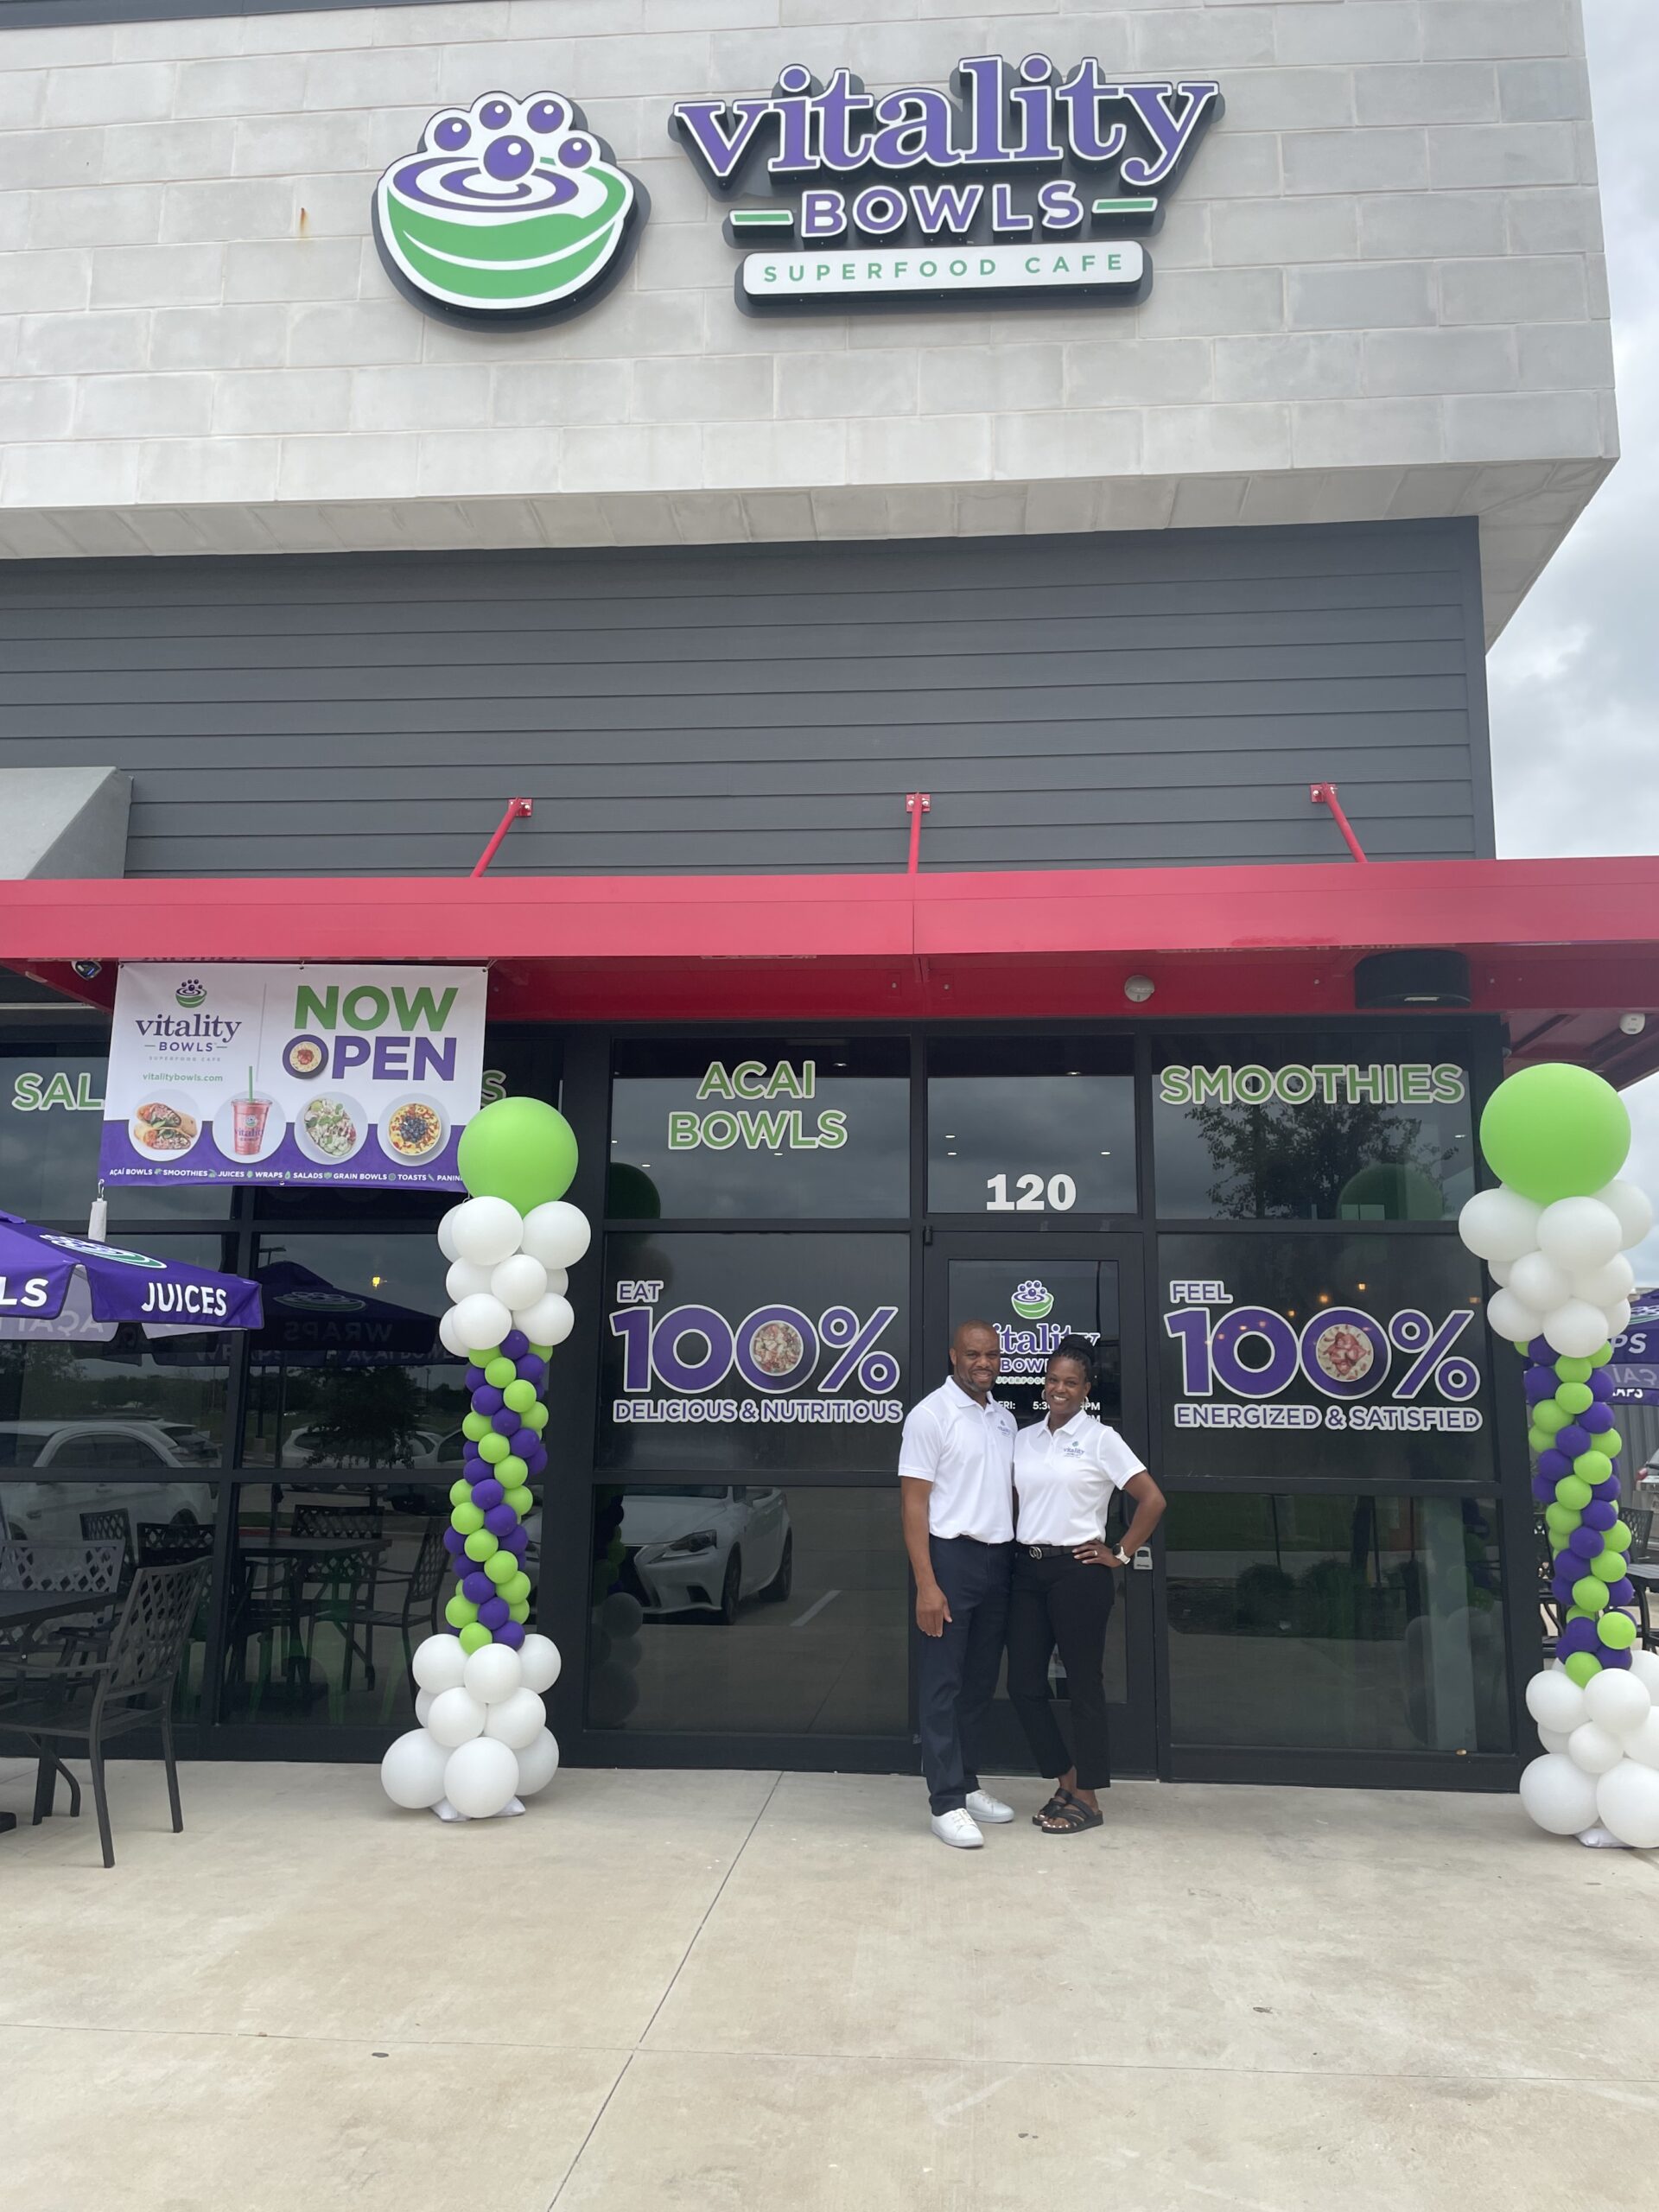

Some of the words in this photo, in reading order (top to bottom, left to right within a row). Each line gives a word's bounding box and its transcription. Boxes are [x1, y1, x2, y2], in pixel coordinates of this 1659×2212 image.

[674, 52, 1220, 188] vitality
[800, 181, 1084, 239] BOWLS
[763, 257, 996, 283] SUPERFOOD
[1025, 253, 1127, 275] CAFE
[295, 985, 459, 1032] NOW
[135, 1014, 242, 1043] vitality
[159, 1041, 213, 1052] BOWLS
[283, 1034, 457, 1081] OPEN
[12, 1072, 105, 1111] SAL
[143, 1072, 223, 1082] vitalitybowls.com
[696, 1060, 816, 1100] ACAI
[1160, 1064, 1465, 1104] SMOOTHIES
[668, 1109, 848, 1150] BOWLS
[986, 1173, 1077, 1211] 120
[141, 1282, 227, 1316] JUICES
[616, 1280, 664, 1303] EAT
[1169, 1280, 1234, 1304] FEEL
[609, 1304, 901, 1394] 100%
[999, 1357, 1049, 1373] BOW
[1163, 1305, 1481, 1402] 100%
[995, 1376, 1046, 1385] UPERFOO
[613, 1399, 737, 1423] DELICIOUS
[741, 1400, 758, 1422] &
[760, 1400, 903, 1423] NUTRITIOUS
[1080, 1402, 1101, 1410] PM
[1173, 1403, 1322, 1429] ENERGIZED
[1325, 1405, 1346, 1430] &
[1348, 1406, 1483, 1432] SATISFIED
